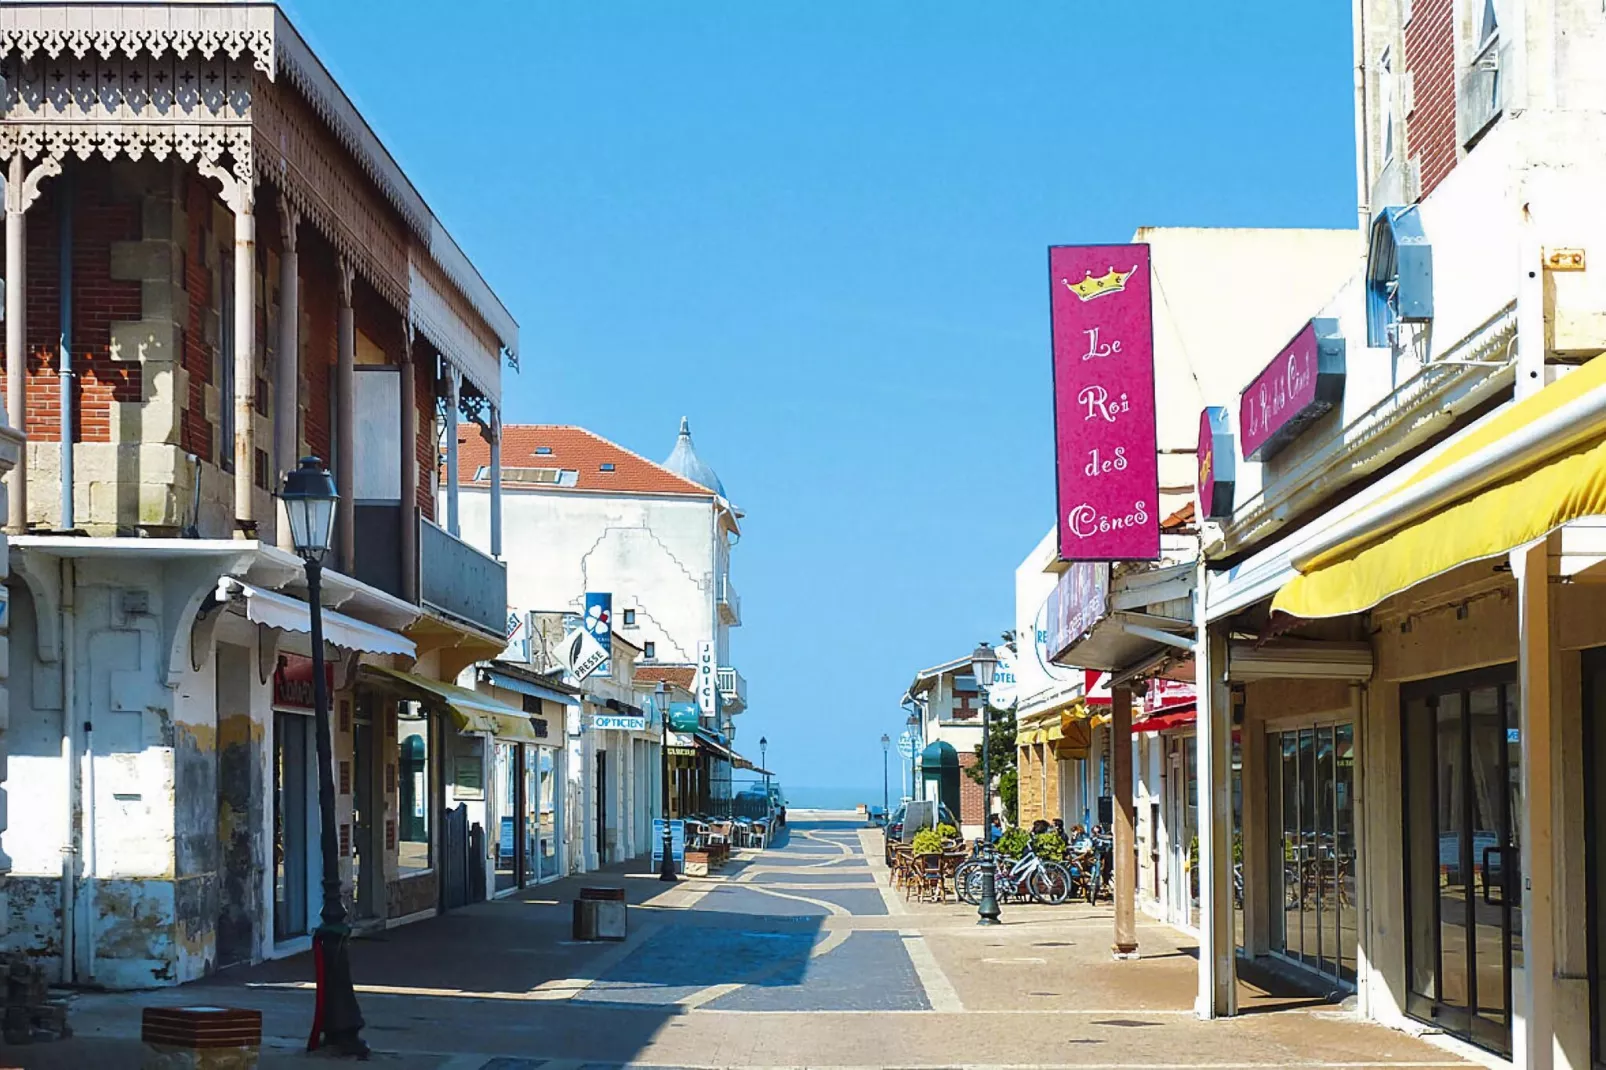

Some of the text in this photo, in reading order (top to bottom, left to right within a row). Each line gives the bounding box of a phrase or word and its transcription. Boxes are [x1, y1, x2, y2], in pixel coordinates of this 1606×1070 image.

[1082, 327, 1122, 361] Le
[1077, 385, 1130, 422] Roi
[574, 650, 605, 678] PRESSE
[702, 644, 712, 708] JUDICI
[993, 672, 1017, 683] OTEL
[595, 717, 645, 729] OPTICIEN
